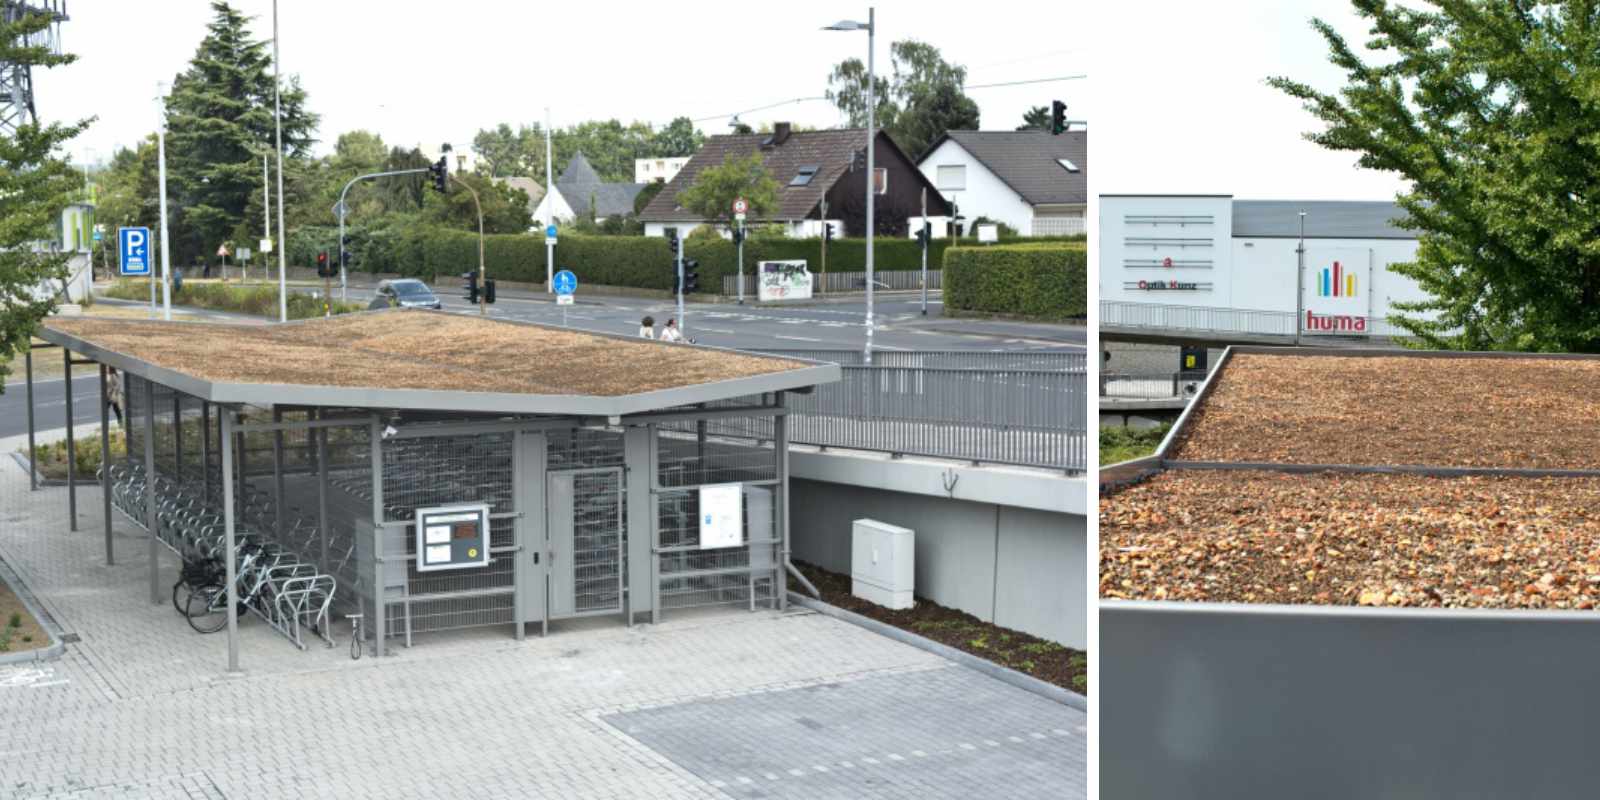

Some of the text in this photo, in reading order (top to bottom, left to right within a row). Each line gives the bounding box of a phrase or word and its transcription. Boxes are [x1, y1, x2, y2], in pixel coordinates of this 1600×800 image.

[127, 231, 144, 256] P
[1138, 280, 1197, 291] Optik Kunz
[1307, 310, 1366, 331] huma
